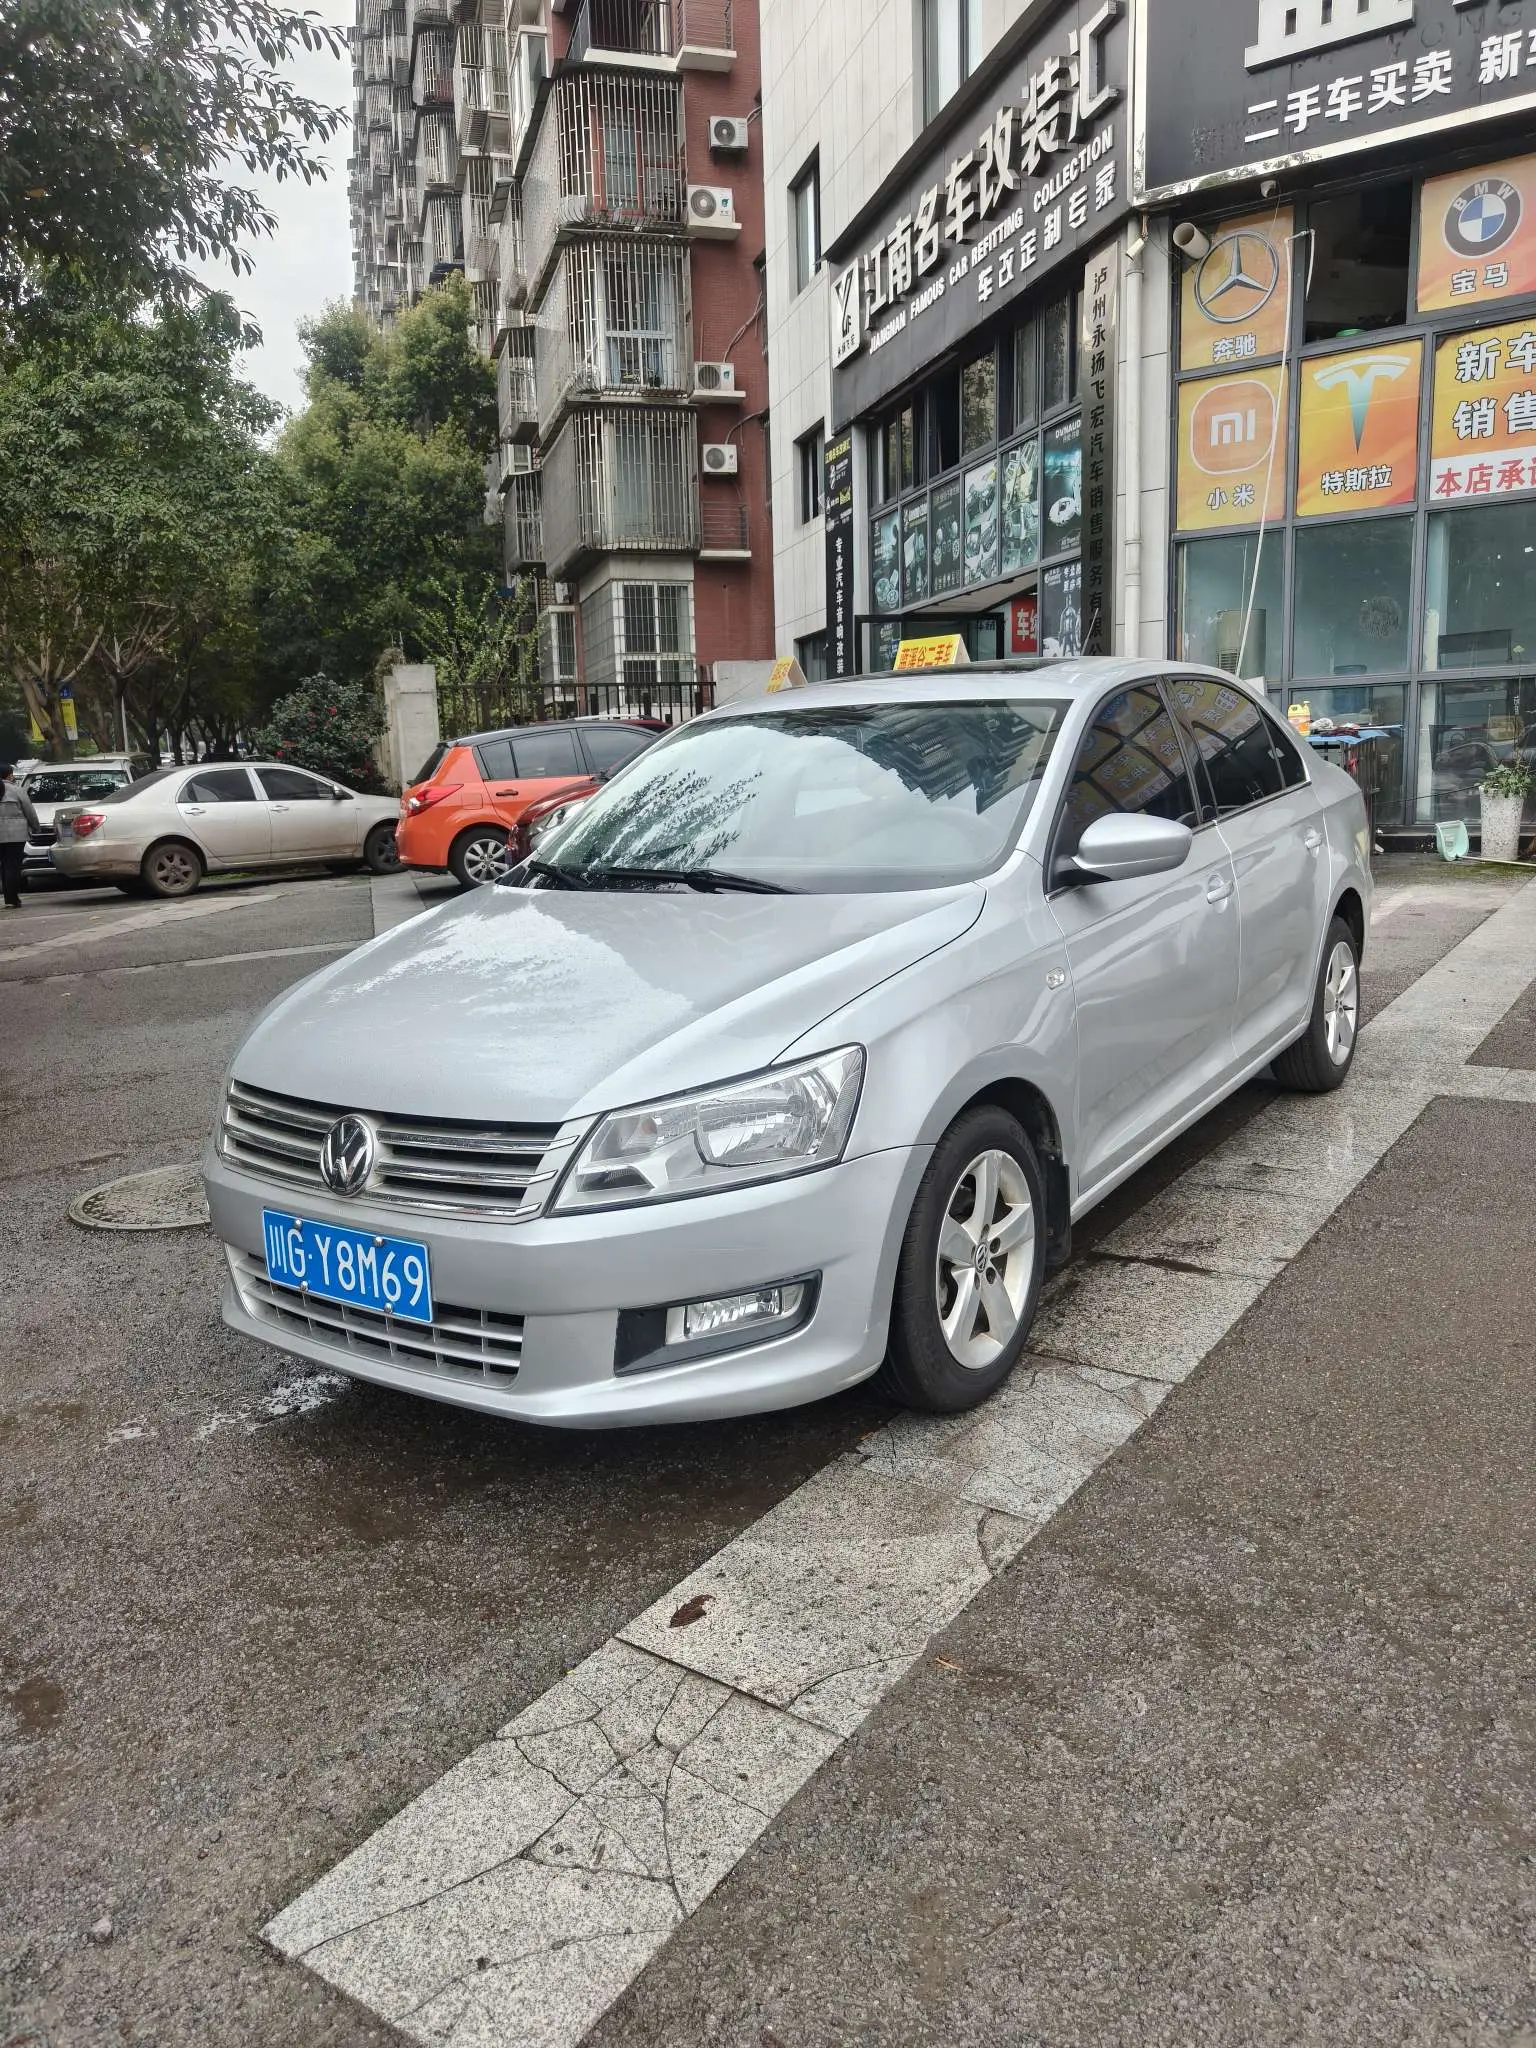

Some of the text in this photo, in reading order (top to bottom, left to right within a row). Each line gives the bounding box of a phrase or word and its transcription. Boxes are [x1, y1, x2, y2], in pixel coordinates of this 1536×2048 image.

[1244, 49, 1452, 143] 二手车买卖
[862, 0, 1120, 331] 江南名车改装汇
[1453, 181, 1515, 211] BMW
[869, 125, 1114, 355] JIANGNAN FAMOUS CAR REFITTING COLLECTION
[977, 160, 1117, 303] 车改定制专家
[1450, 262, 1509, 297] 宝马
[1212, 333, 1257, 363] 奔驰
[1454, 331, 1536, 384] 新车
[1452, 390, 1536, 441] 销售
[1206, 483, 1256, 511] 小米
[1320, 464, 1393, 496] 特斯拉
